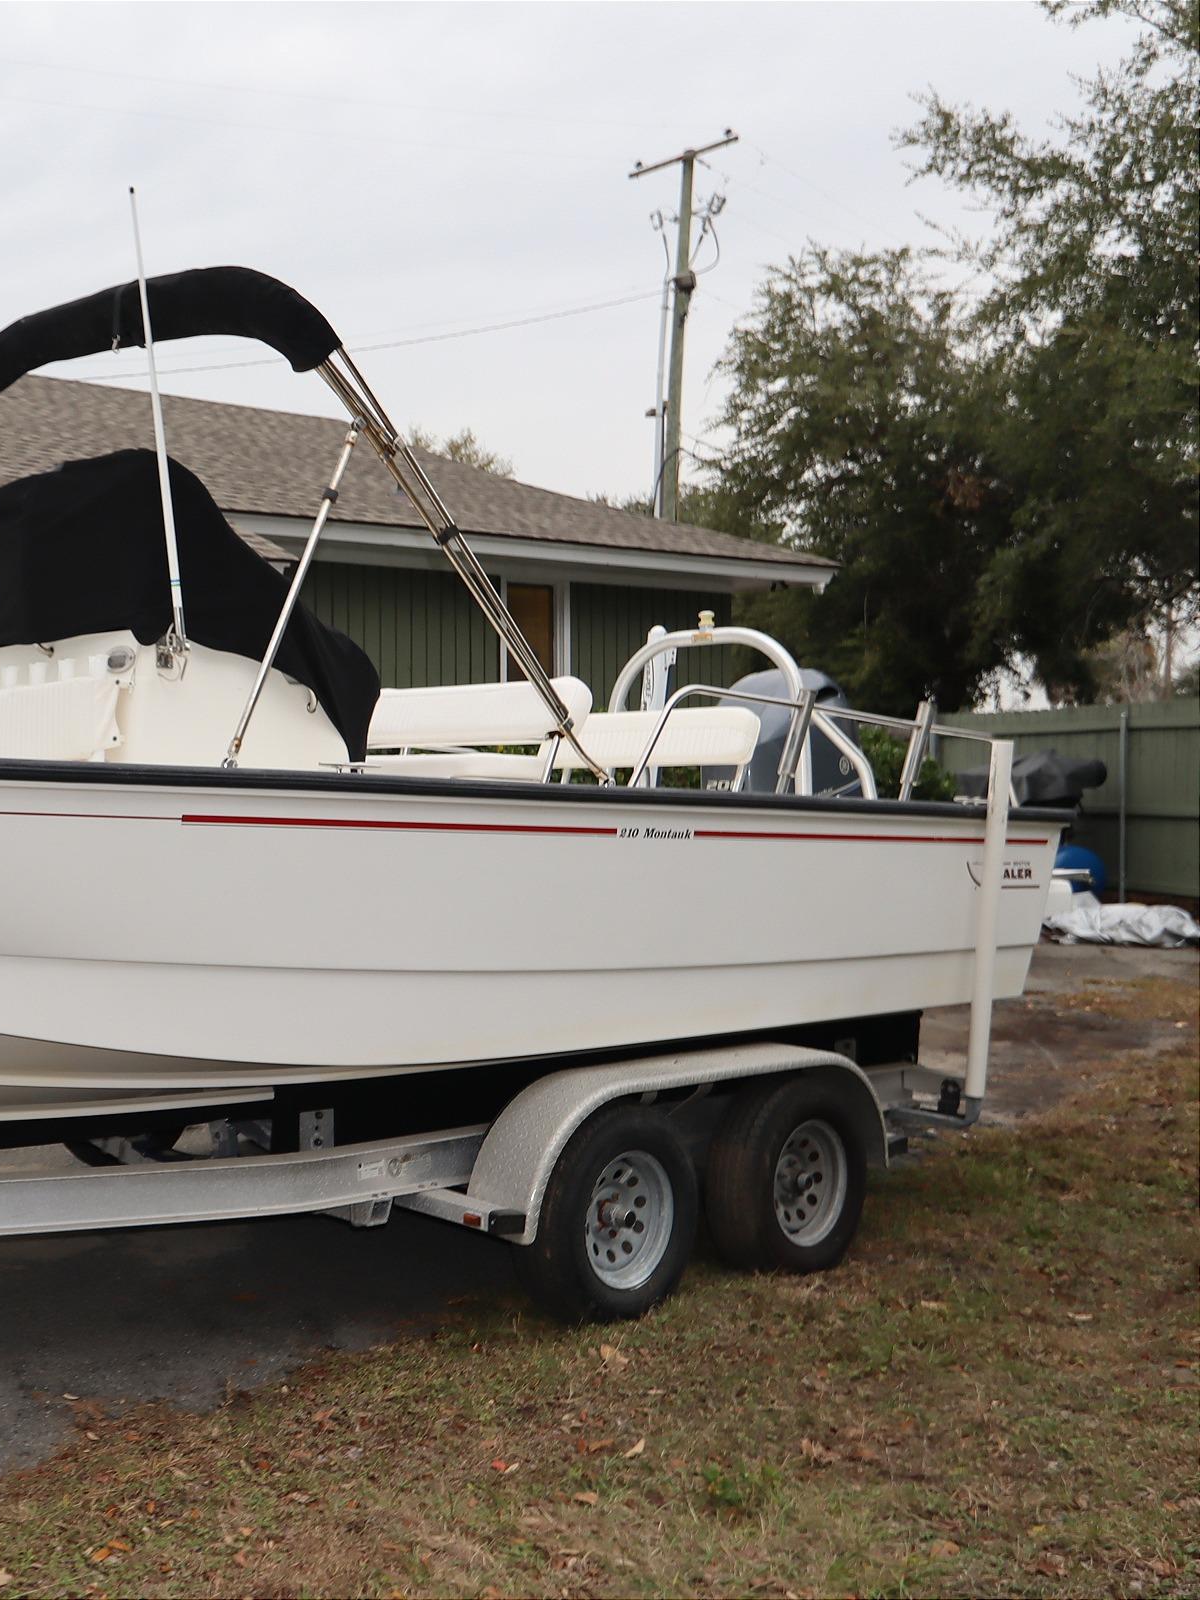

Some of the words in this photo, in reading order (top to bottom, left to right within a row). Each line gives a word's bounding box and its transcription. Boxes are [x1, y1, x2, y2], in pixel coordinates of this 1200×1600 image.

[706, 780, 736, 792] 20
[619, 828, 640, 839] 210
[643, 828, 692, 839] Montauk
[1003, 868, 1033, 880] ALER
